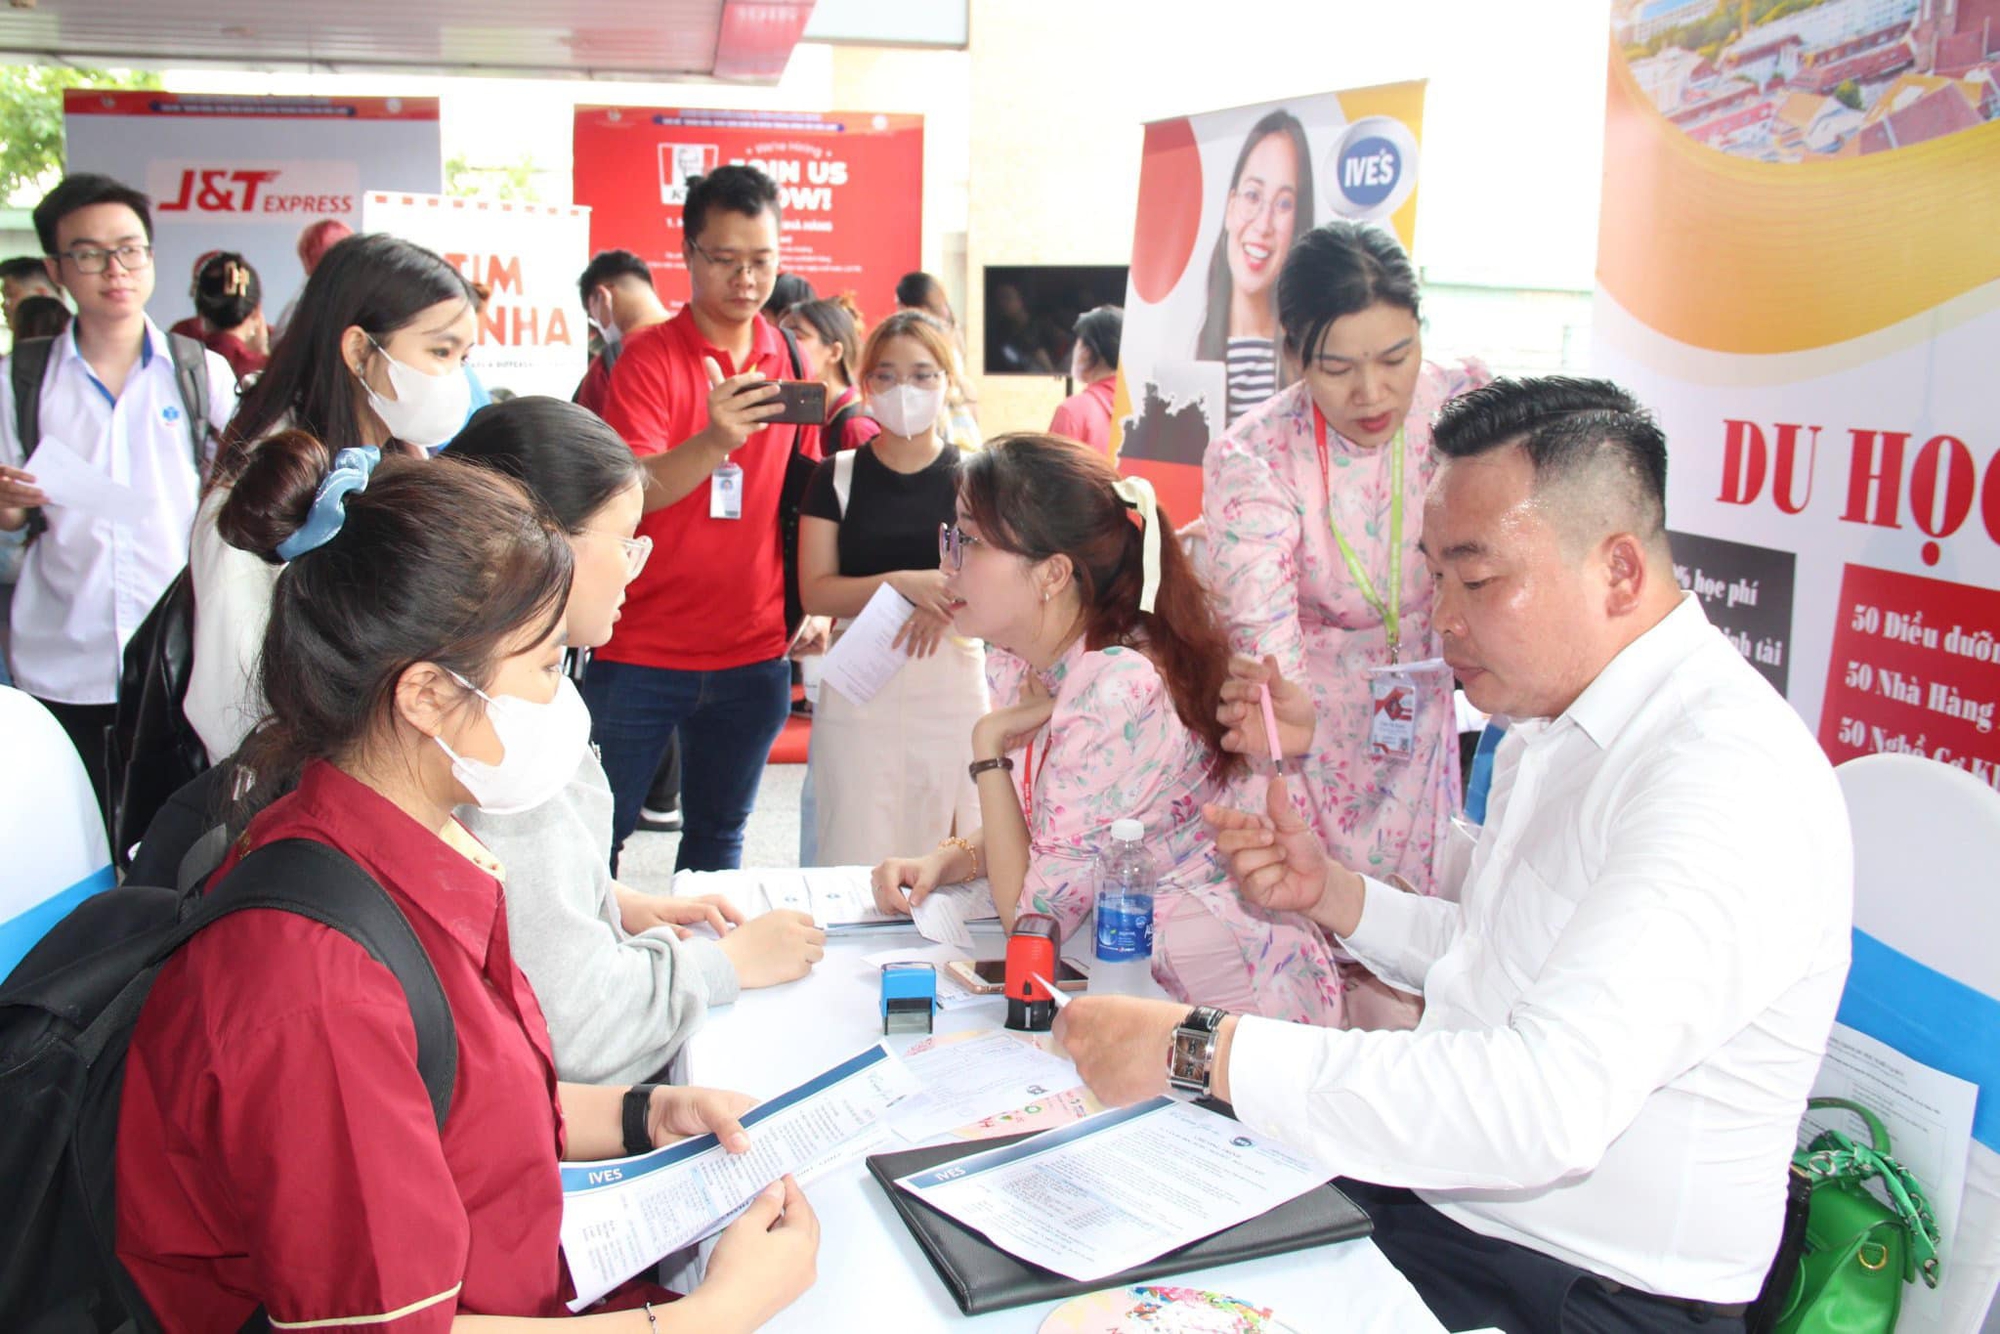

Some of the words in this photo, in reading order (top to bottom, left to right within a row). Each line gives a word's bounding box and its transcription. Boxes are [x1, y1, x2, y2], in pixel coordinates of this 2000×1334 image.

[807, 161, 848, 185] US
[157, 169, 282, 212] J&T
[263, 195, 353, 213] EXPRESS
[778, 187, 832, 210] OW!
[1716, 419, 1823, 515] DU
[1694, 568, 1726, 602] học
[1727, 578, 1759, 608] phí
[1851, 603, 1880, 635] 50
[1755, 637, 1782, 666] tài
[1845, 661, 1873, 691] 50
[1875, 668, 1922, 706] Nhà
[1927, 682, 1995, 734] Hàng
[1838, 716, 1866, 748] 50
[588, 1168, 623, 1185] IVES
[936, 1167, 967, 1182] IVES
